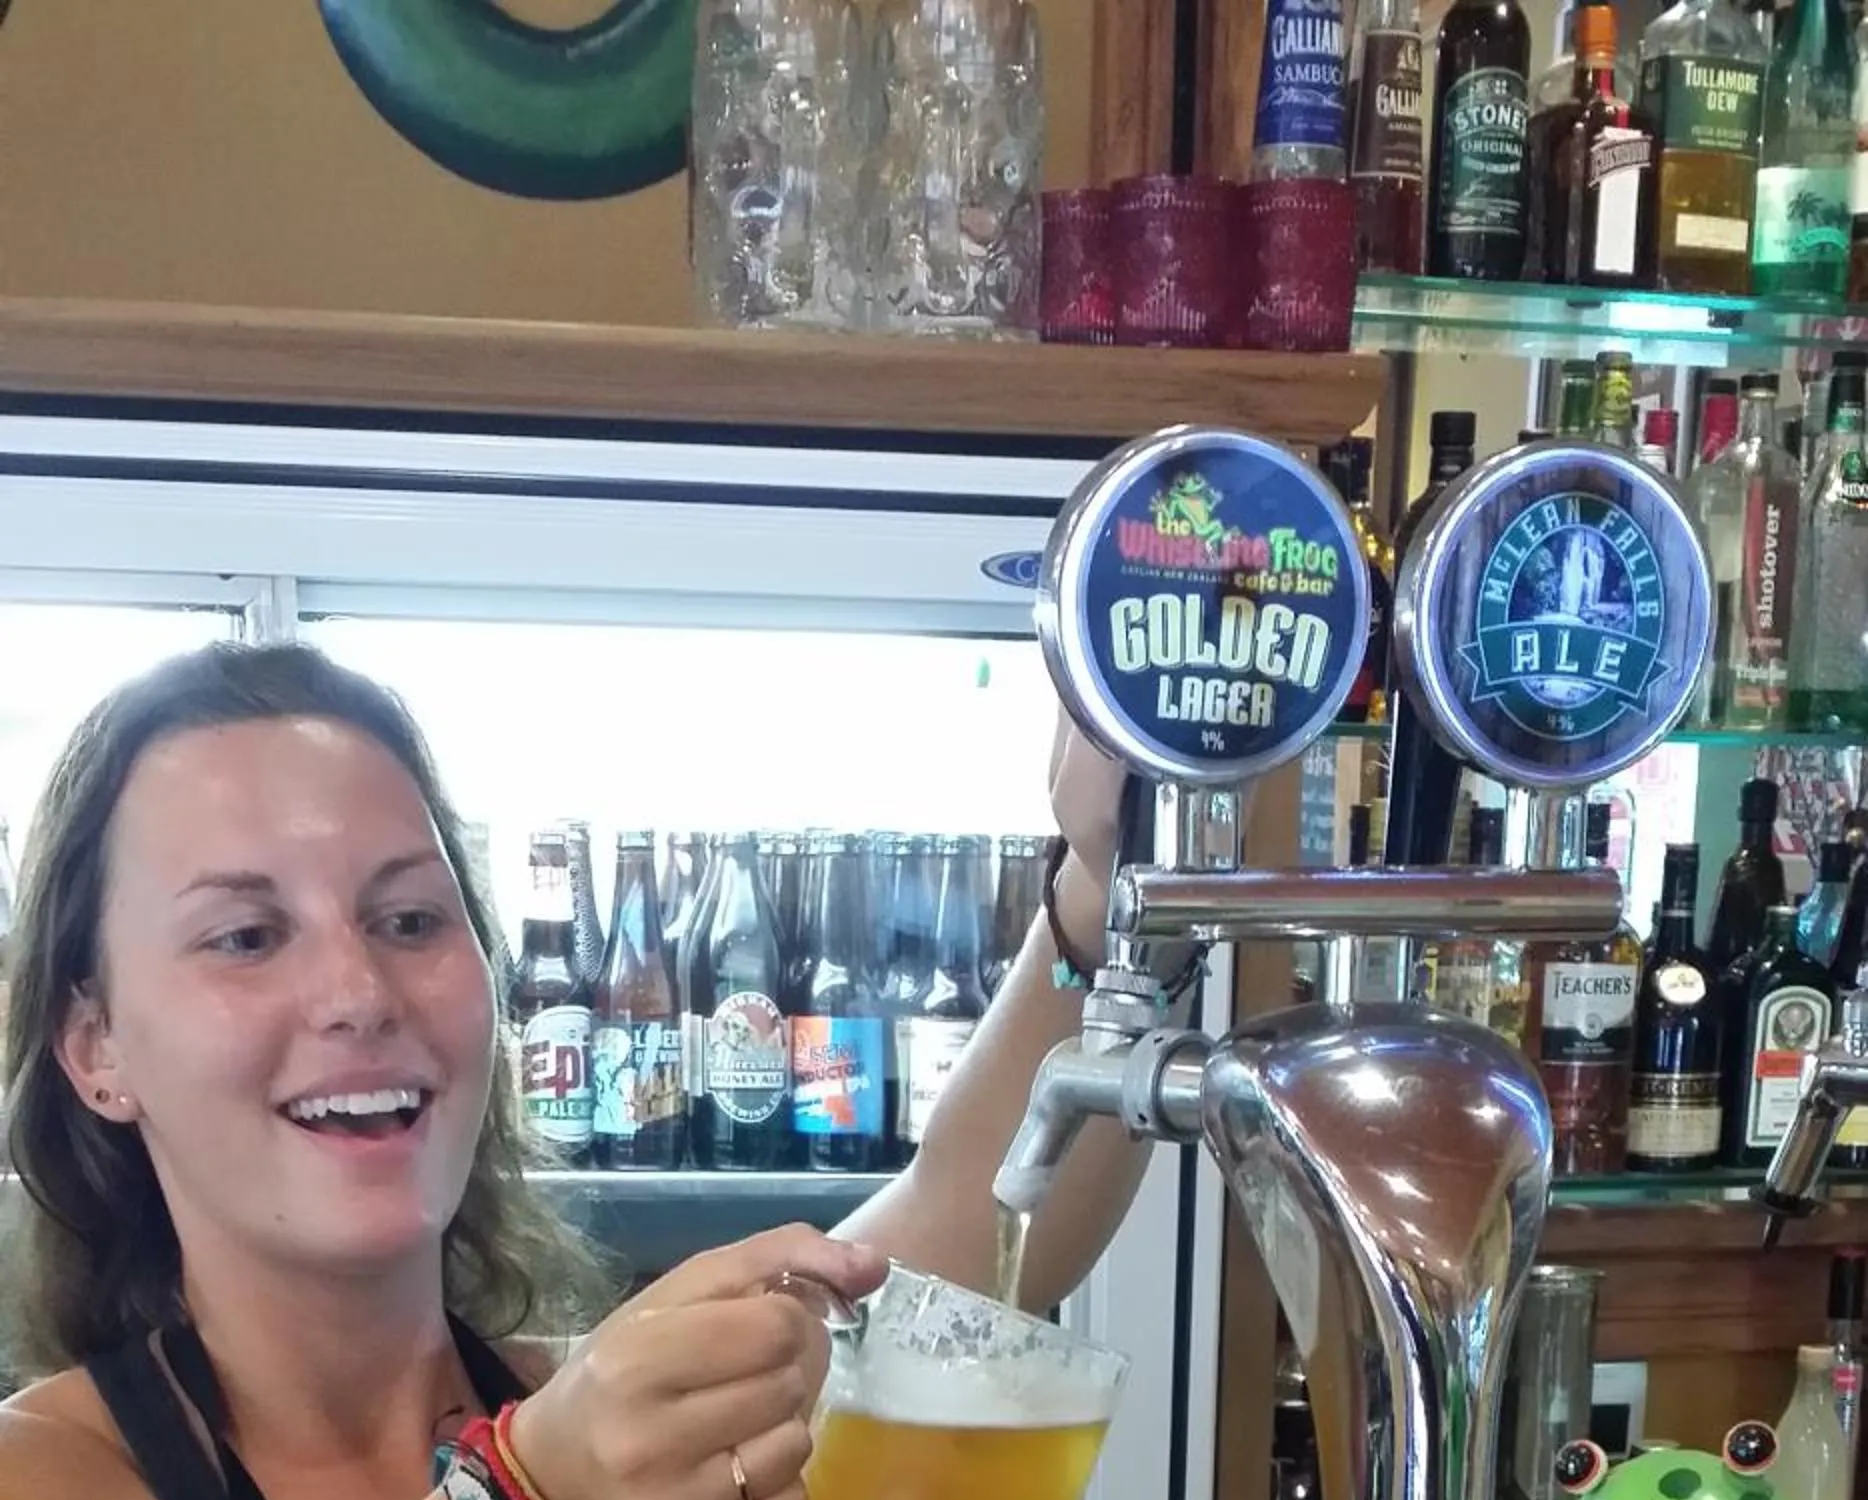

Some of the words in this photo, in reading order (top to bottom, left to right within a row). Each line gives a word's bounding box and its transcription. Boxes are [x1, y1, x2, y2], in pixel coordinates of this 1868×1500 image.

[1272, 15, 1344, 59] GALLIAN
[1274, 63, 1343, 85] SAMBUC
[1682, 61, 1760, 95] TULLAMORE
[1707, 91, 1739, 113] DEW
[1157, 512, 1191, 537] the
[1268, 527, 1338, 579] FROG
[1600, 506, 1660, 618] FALLS
[1756, 503, 1781, 630] shotover
[1109, 592, 1331, 693] GOLDEN
[1510, 628, 1628, 684] ALE
[1156, 674, 1277, 728] LAGER
[1553, 971, 1633, 999] TEACHER'S
[760, 1073, 784, 1084] ALE
